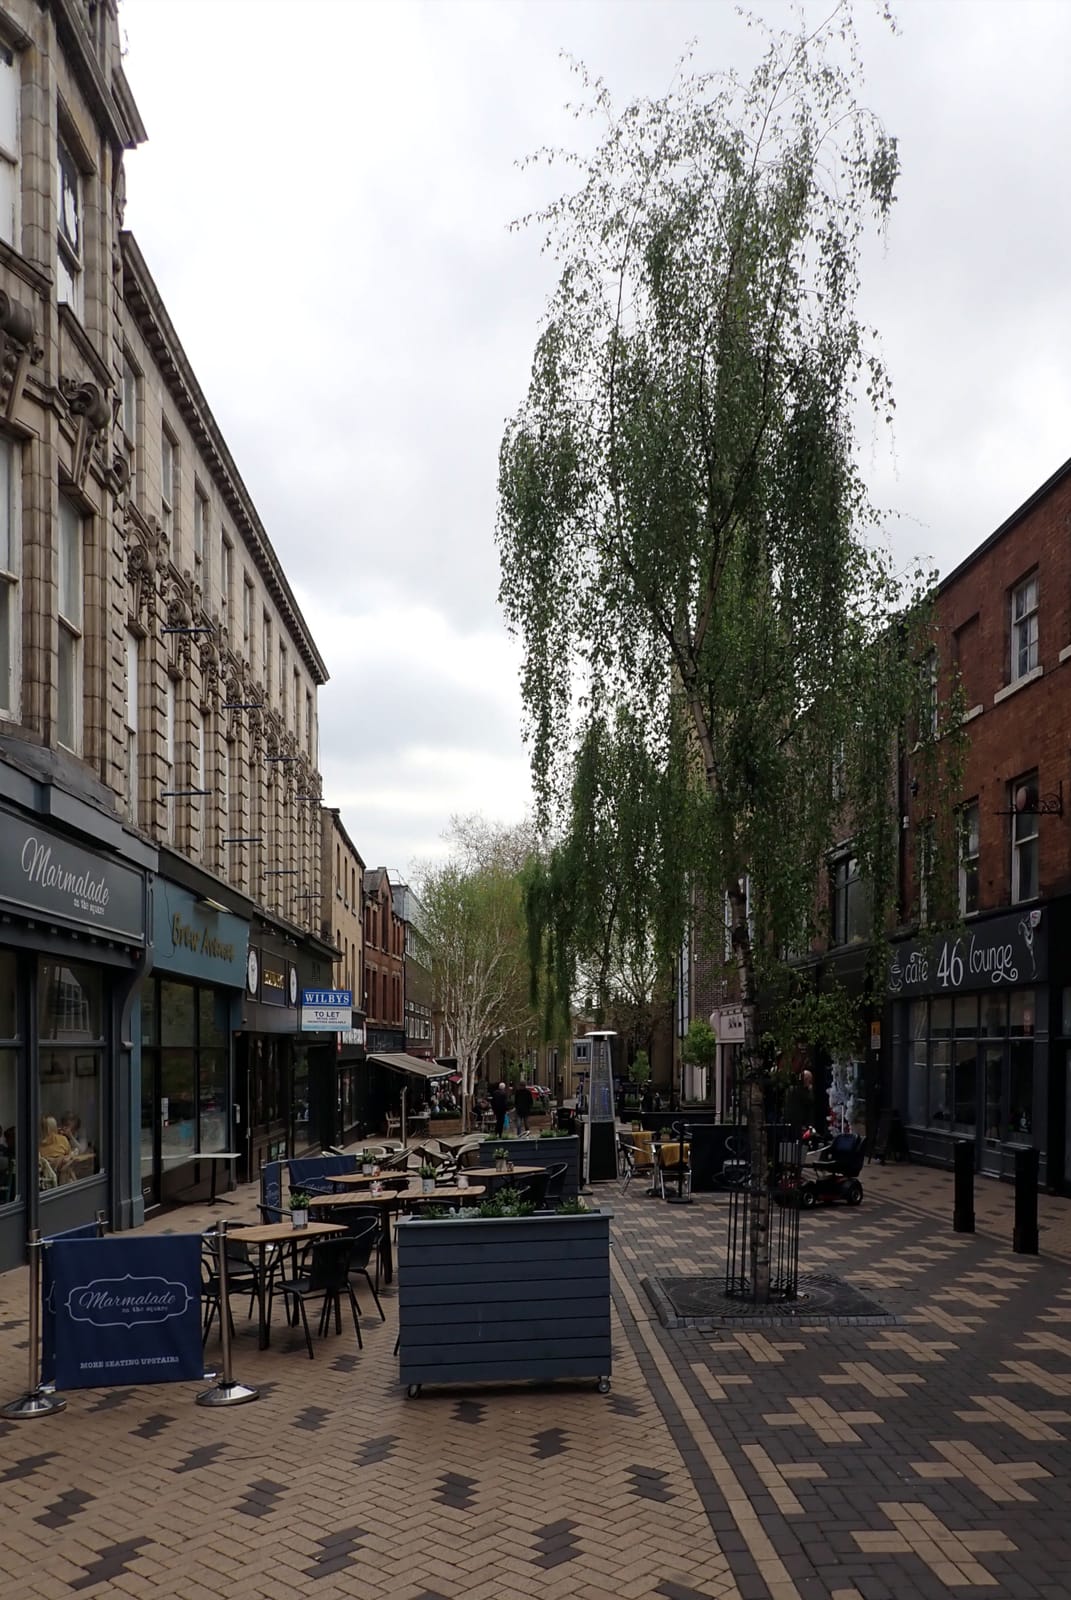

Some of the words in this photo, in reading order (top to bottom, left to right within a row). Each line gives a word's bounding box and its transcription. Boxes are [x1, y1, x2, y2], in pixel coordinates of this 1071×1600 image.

[22, 837, 110, 906] Marmalade
[89, 903, 105, 916] square
[937, 938, 964, 988] 46
[969, 934, 1019, 984] lounge
[305, 993, 350, 1004] WILBYS
[326, 1011, 341, 1019] LET
[79, 1290, 176, 1310] Marmalade
[146, 1305, 168, 1313] square
[80, 1361, 105, 1370] MORE
[105, 1359, 140, 1368] SEATING
[141, 1356, 179, 1366] UPSTAIRS
